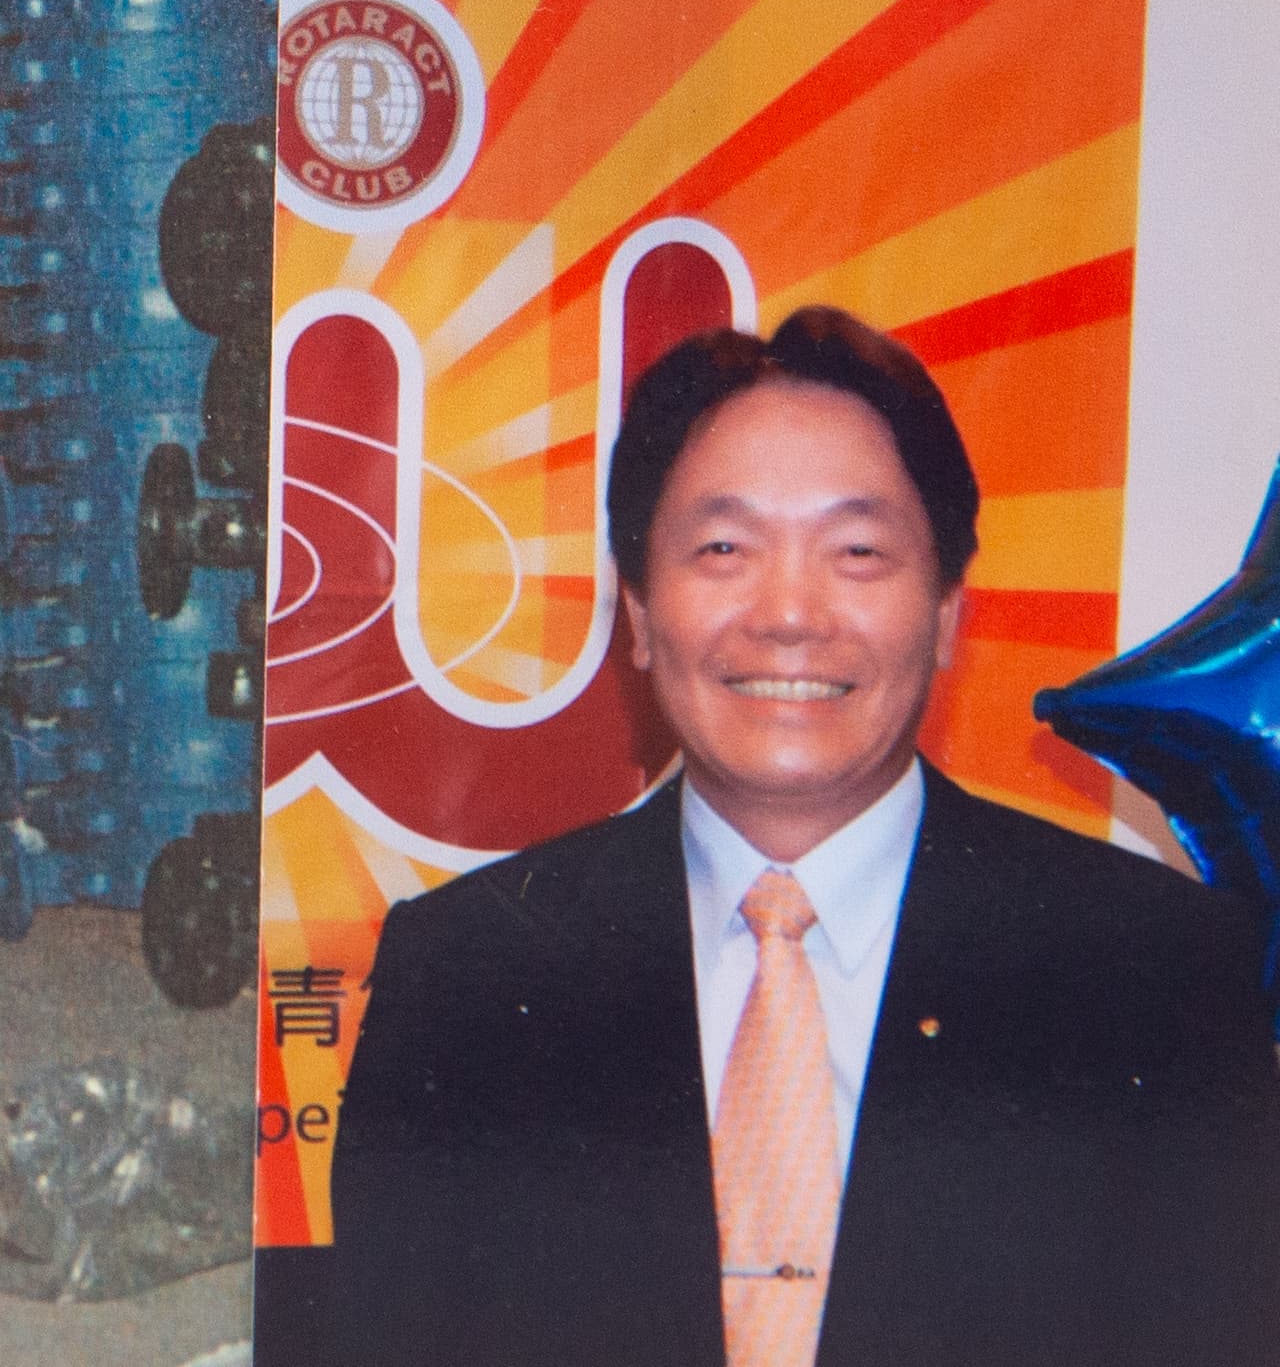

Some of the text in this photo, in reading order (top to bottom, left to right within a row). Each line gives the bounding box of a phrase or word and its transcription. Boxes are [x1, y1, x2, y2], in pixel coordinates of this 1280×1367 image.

[326, 54, 396, 151] R
[300, 160, 414, 200] CLUB
[267, 965, 371, 1048] 青
[256, 1089, 345, 1159] pe
